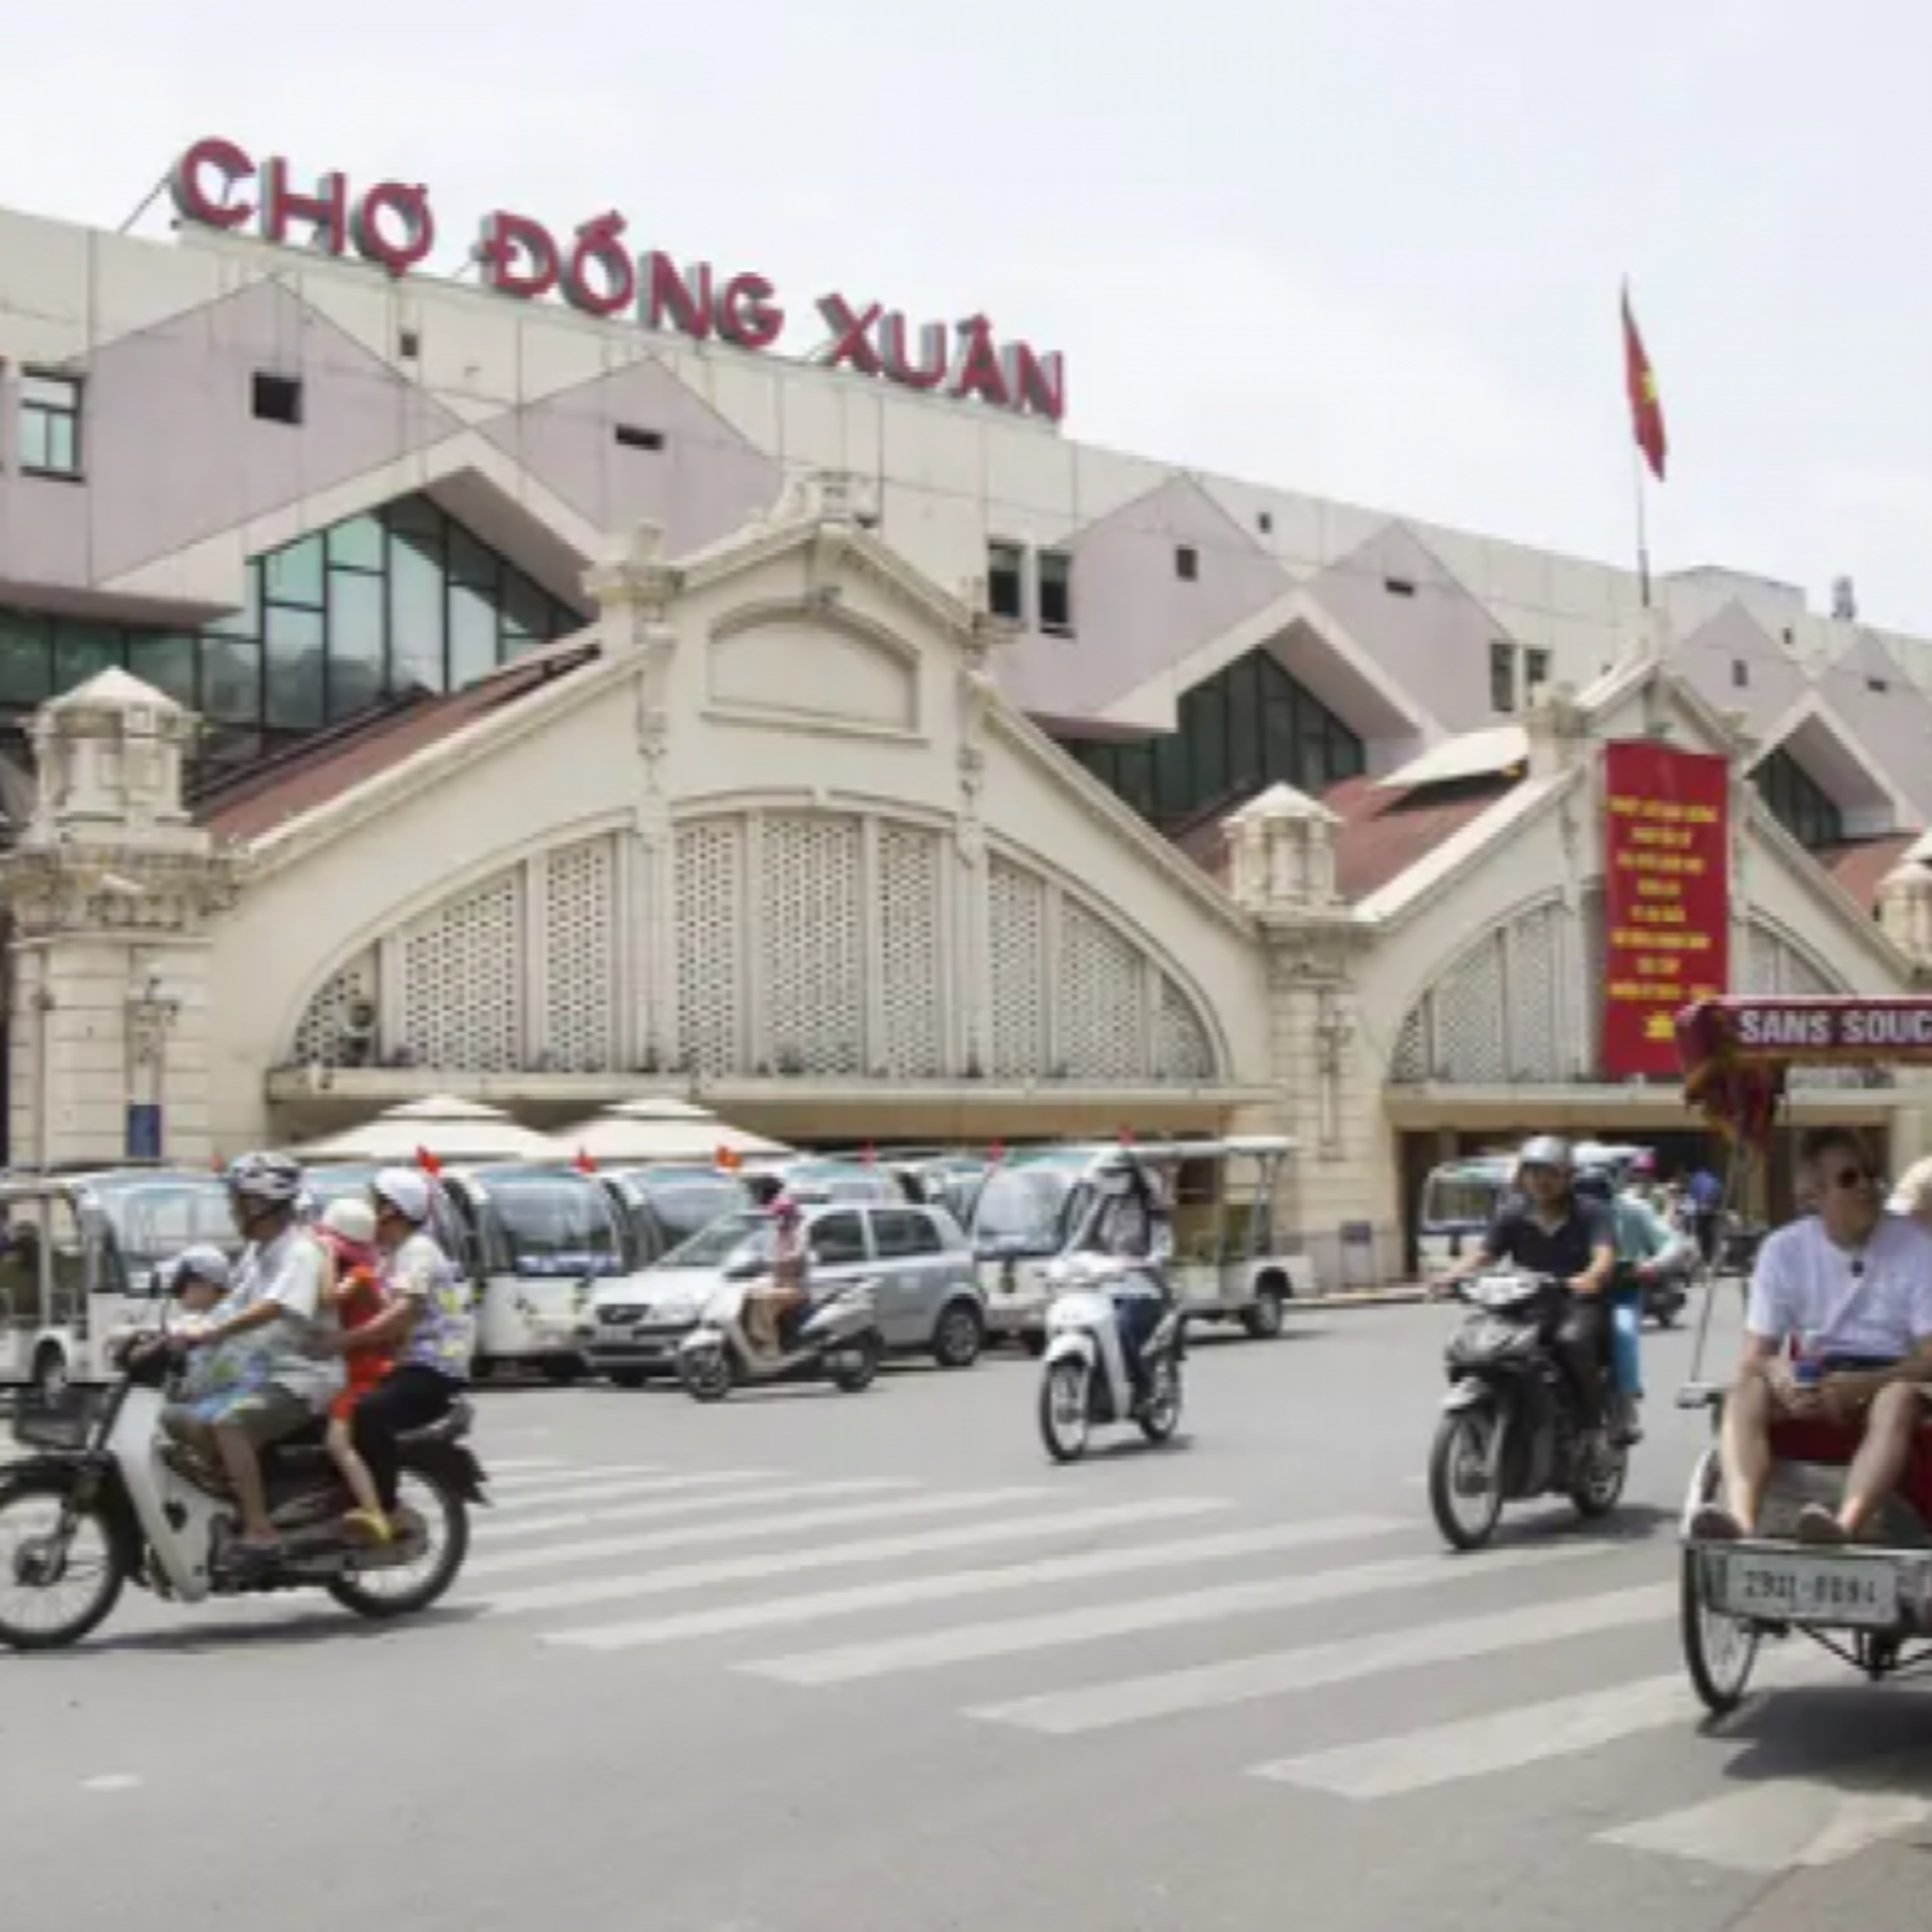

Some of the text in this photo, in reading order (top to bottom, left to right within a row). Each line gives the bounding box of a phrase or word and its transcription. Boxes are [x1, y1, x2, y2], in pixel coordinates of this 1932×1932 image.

[171, 137, 434, 278] CHỢ
[815, 293, 1063, 423] XUÂN
[1740, 1009, 1831, 1044] SANS
